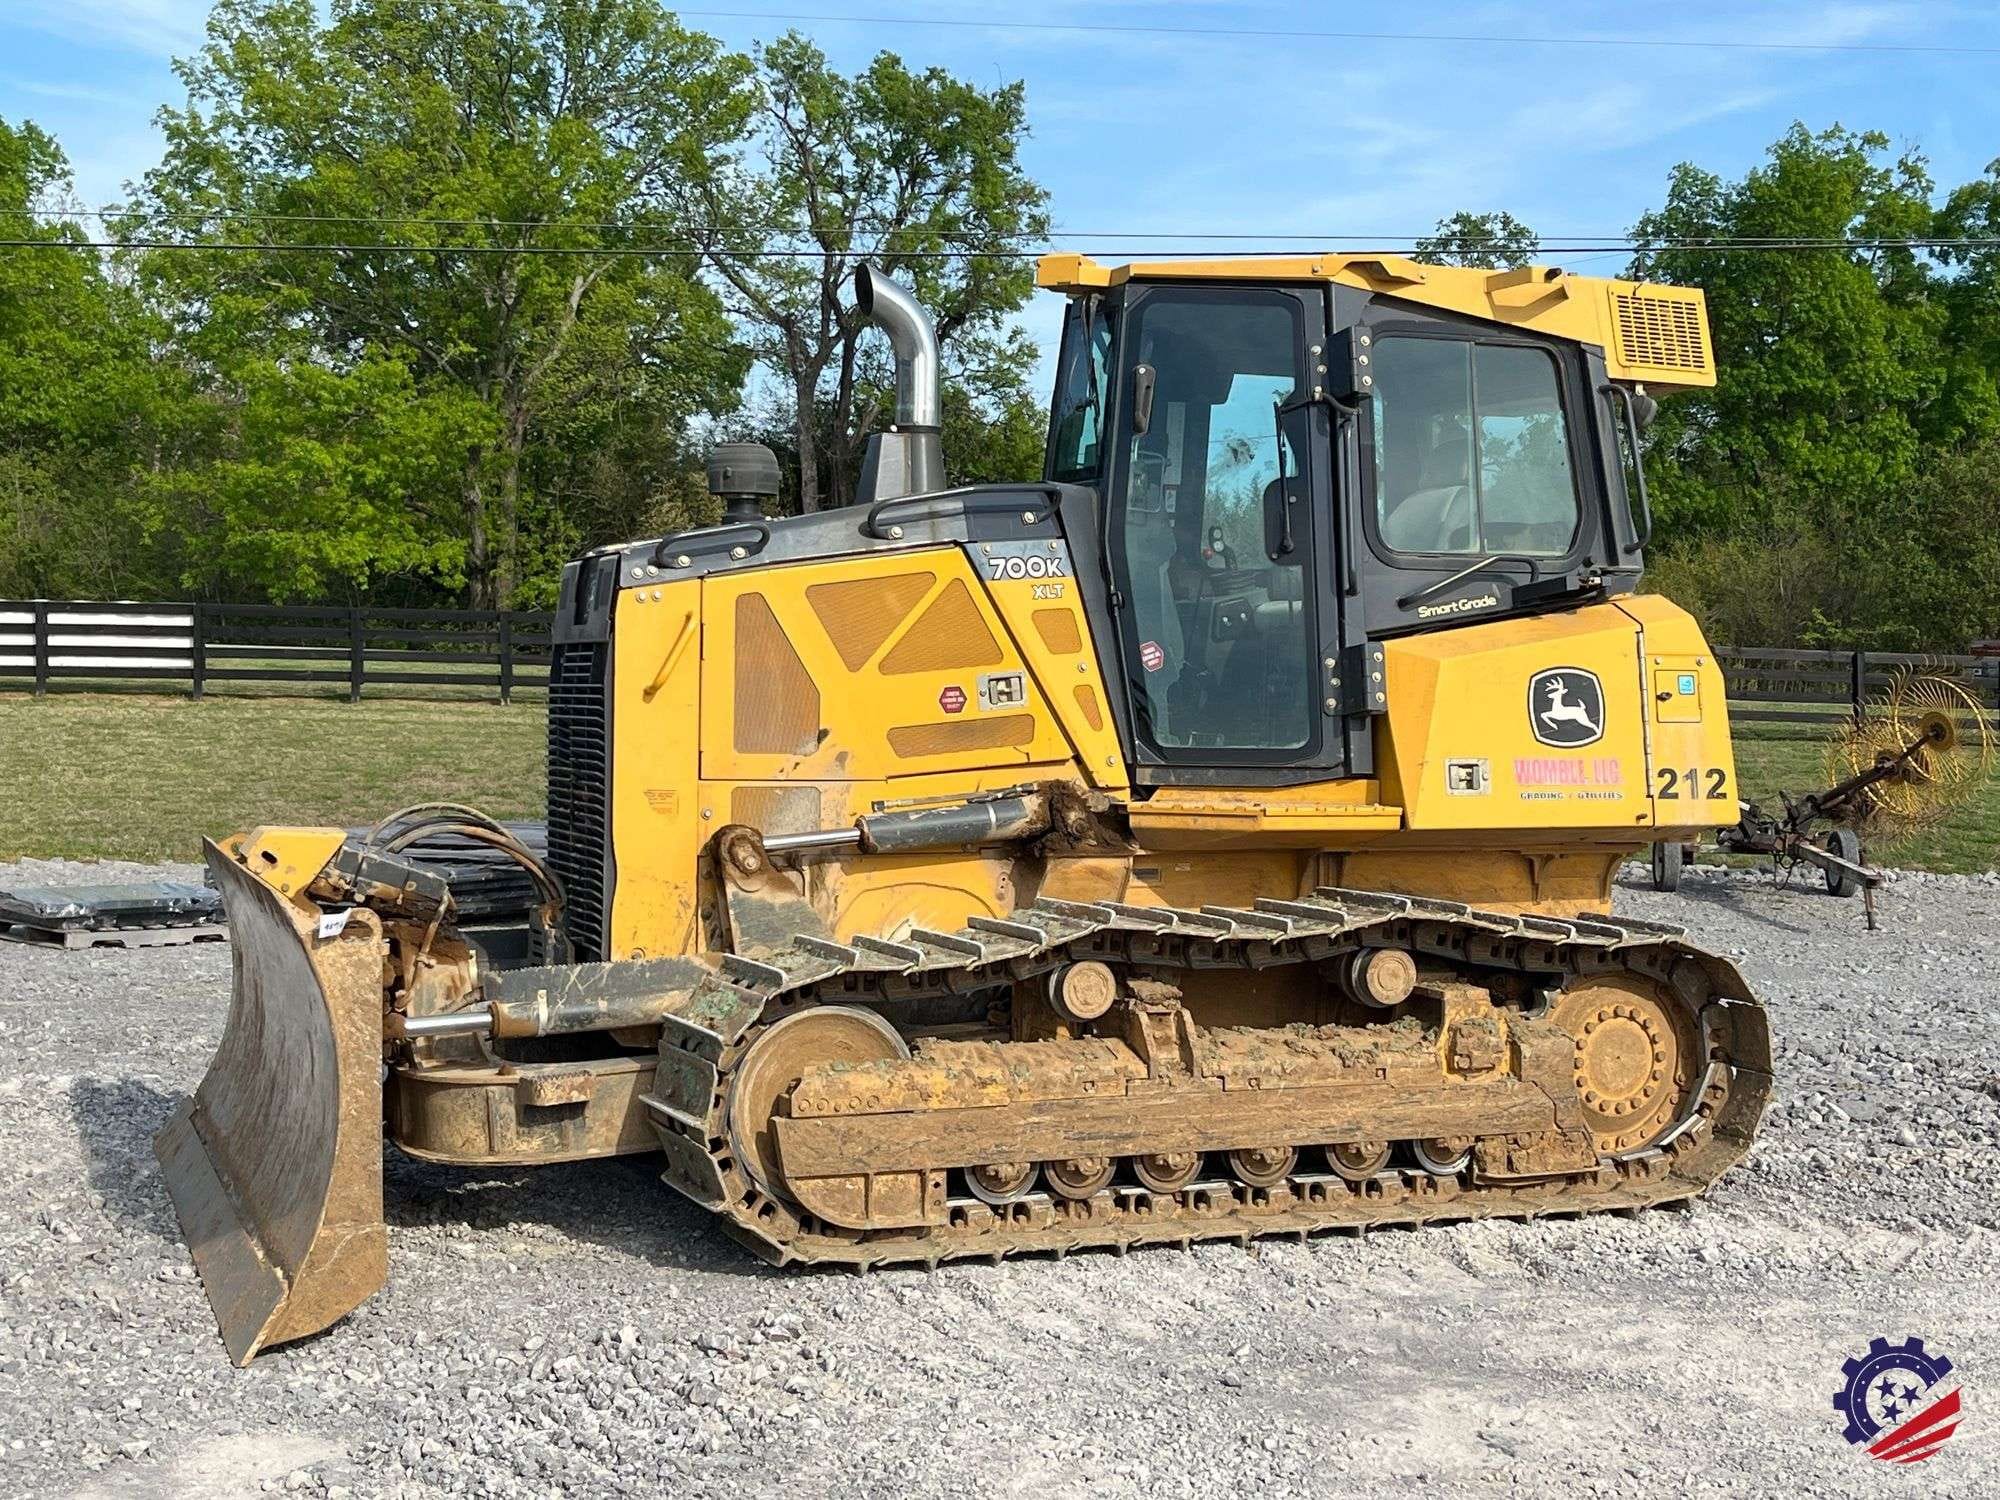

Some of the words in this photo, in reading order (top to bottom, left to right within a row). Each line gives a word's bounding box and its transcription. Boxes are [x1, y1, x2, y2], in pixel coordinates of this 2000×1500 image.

[989, 555, 1064, 580] 700K
[1032, 584, 1064, 600] XLT
[1657, 768, 1727, 800] 212
[1520, 791, 1564, 800] GRADING
